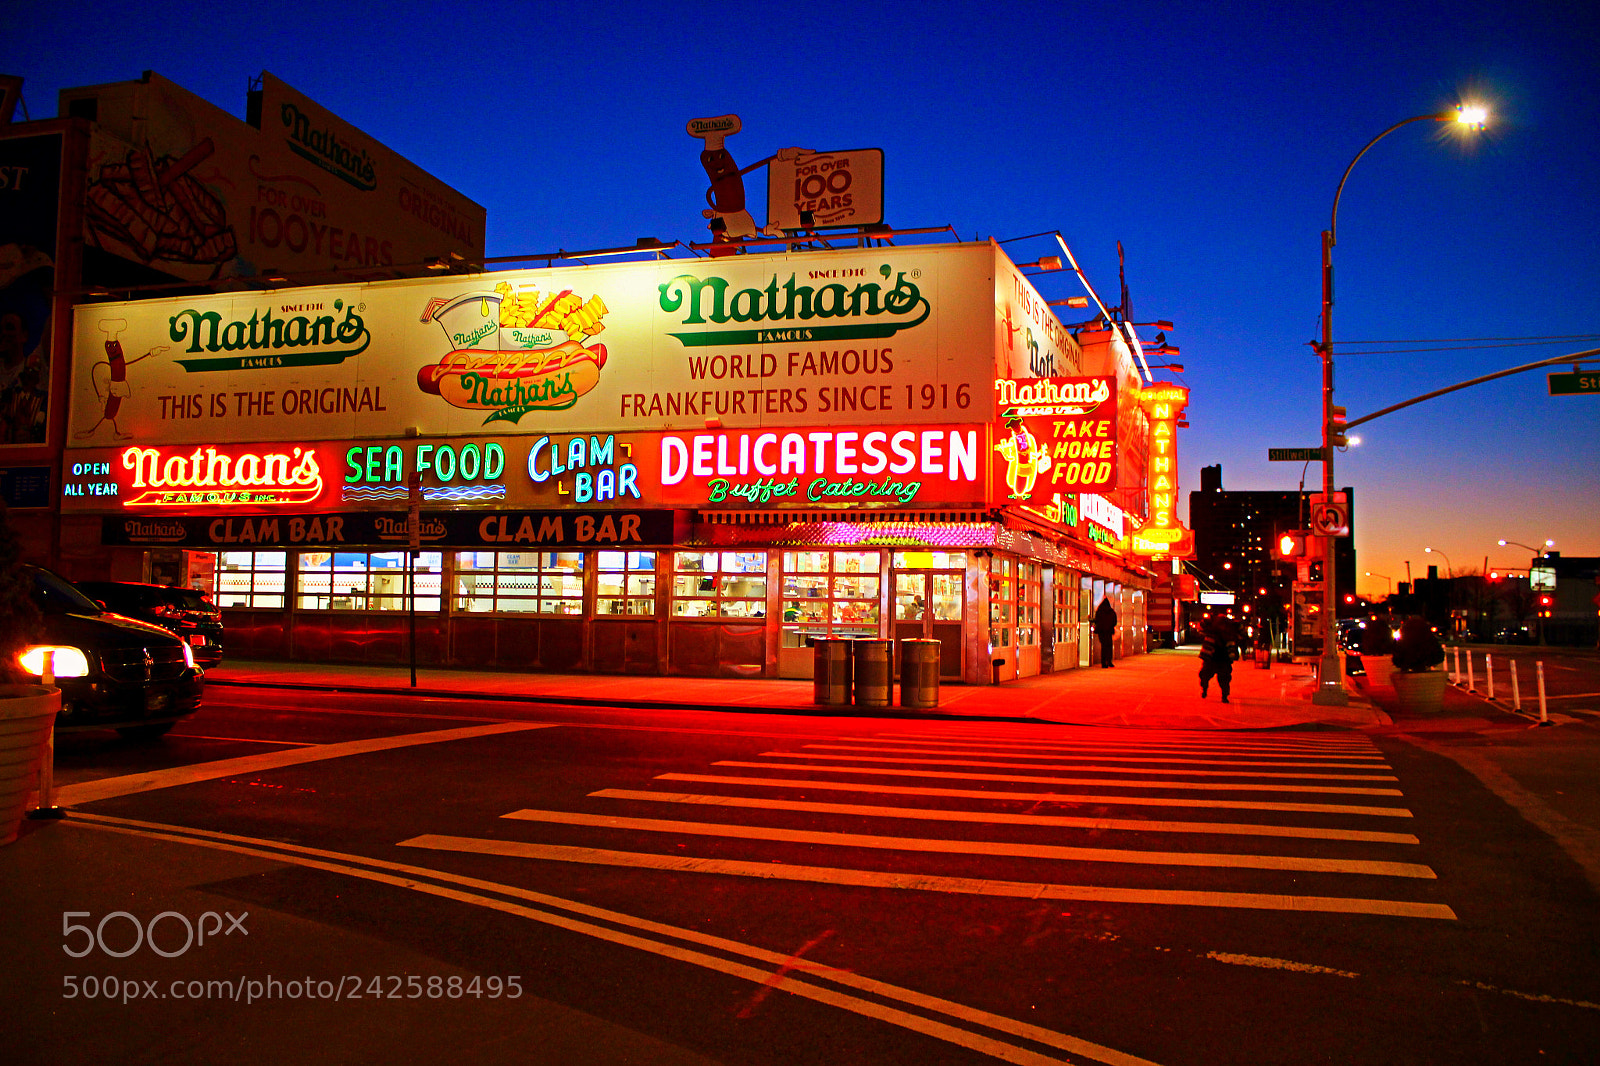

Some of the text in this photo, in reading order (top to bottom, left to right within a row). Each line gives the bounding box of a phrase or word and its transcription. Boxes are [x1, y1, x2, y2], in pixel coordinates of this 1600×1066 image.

[691, 118, 736, 133] Nathan's
[281, 103, 376, 185] Nathan's
[796, 159, 849, 177] FOR OVER
[795, 169, 852, 201] 100
[257, 185, 326, 219] FOR OVER
[794, 194, 853, 215] YEARS
[399, 186, 474, 248] ORIGINAL
[808, 267, 866, 279] SINCE 1916
[281, 304, 304, 313] SINCE
[658, 263, 930, 327] Nathan's
[1013, 273, 1030, 316] THIS
[1032, 298, 1039, 325] IS
[1041, 307, 1053, 342] THE
[169, 298, 371, 355] Nathan's
[453, 319, 498, 346] Nathan's
[512, 330, 553, 345] Nathan's
[757, 329, 813, 343] FAMOUS
[241, 356, 282, 368] FAMOUS
[689, 347, 894, 381] WORLD FAMOUS
[461, 371, 578, 407] Nathan's
[994, 378, 1110, 405] Nathan's
[1140, 388, 1186, 401] ORIGINAL
[1580, 376, 1600, 389] St
[158, 386, 387, 419] THIS IS THE ORIGINAL
[620, 382, 971, 418] FRANKFURTERS SINCE 1916
[1053, 420, 1110, 438] TAKE
[345, 442, 505, 482] SEA FOOD
[528, 435, 615, 482] CLAM
[660, 430, 977, 485] DELICATESSEN
[1053, 441, 1114, 459] HOME
[1271, 449, 1310, 460] Stillwell
[73, 462, 110, 476] OPEN
[122, 446, 322, 490] Nathan's
[1051, 461, 1112, 485] FOOD
[1153, 402, 1171, 527] NATHANS
[64, 483, 85, 497] ALL
[88, 482, 118, 496] YEAR
[575, 462, 641, 503] BAR
[708, 475, 921, 503] Buffet Catering
[163, 492, 252, 503] FAMOUS
[124, 519, 187, 538] Nathan's
[208, 515, 345, 543] CLAM BAR
[374, 516, 447, 537] Natan's
[479, 513, 643, 543] CLAM BAR
